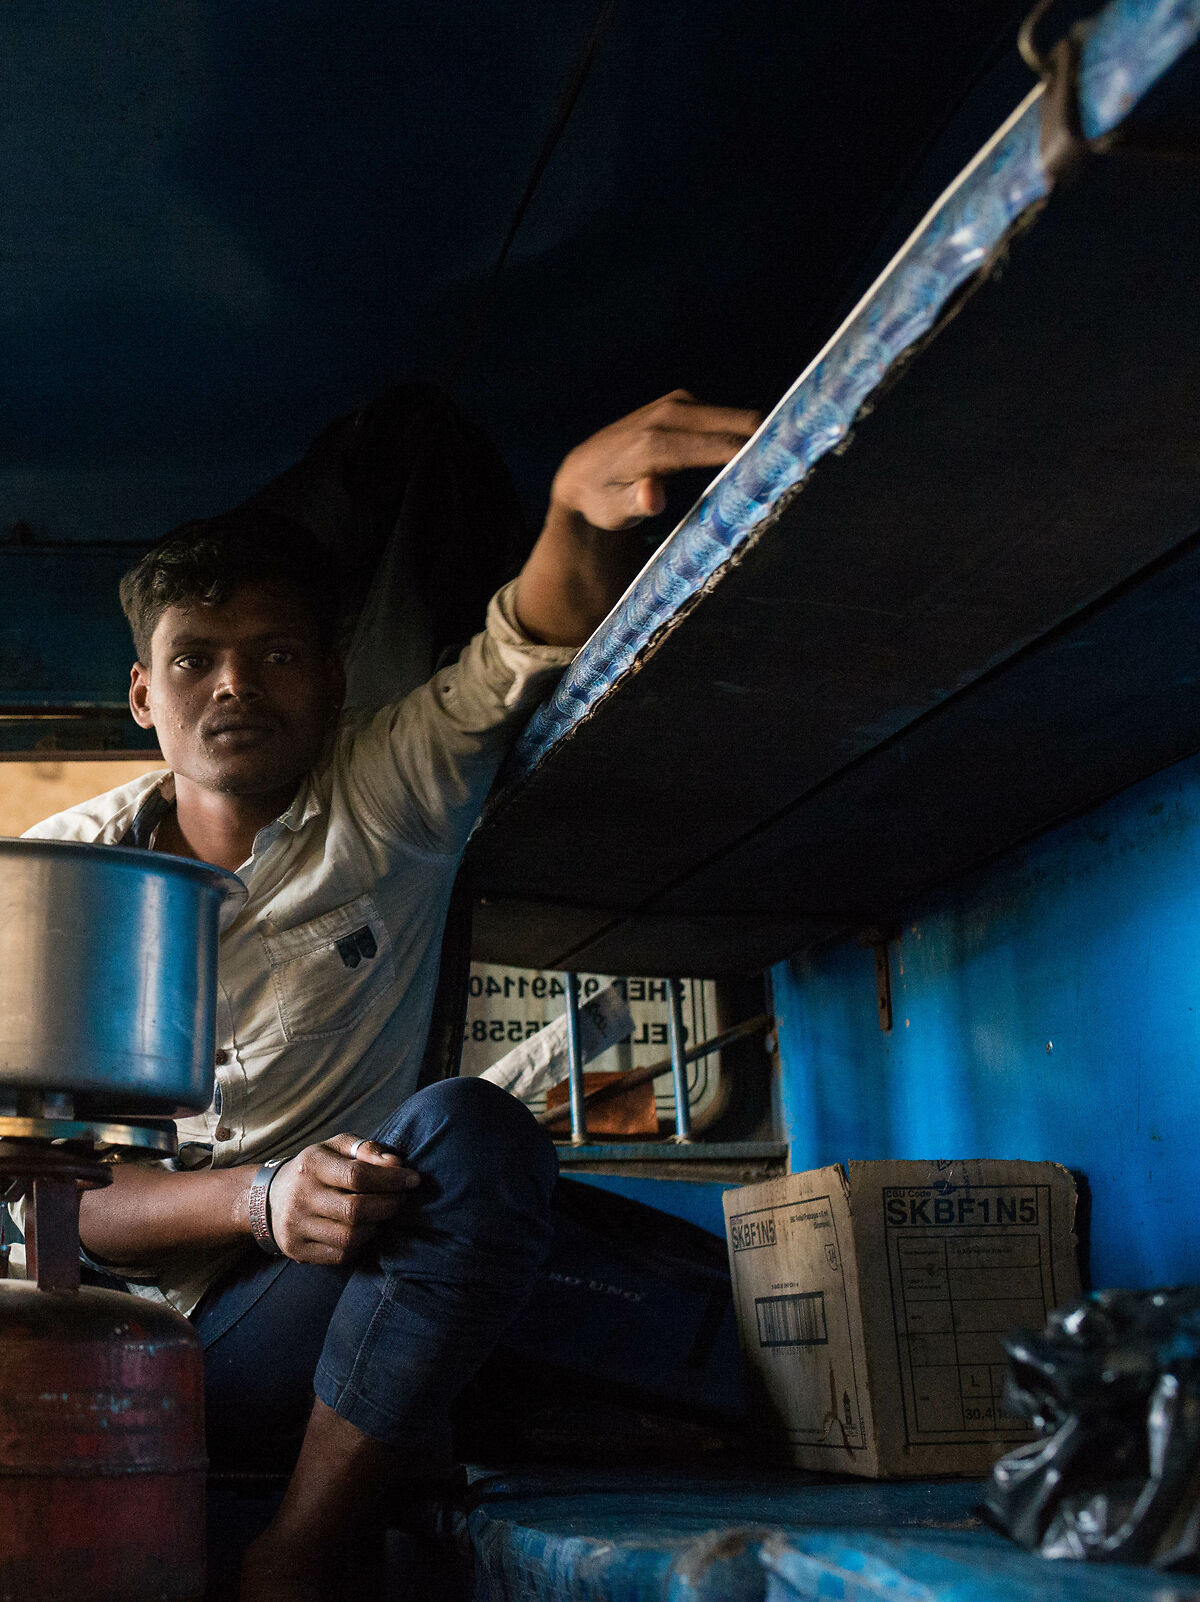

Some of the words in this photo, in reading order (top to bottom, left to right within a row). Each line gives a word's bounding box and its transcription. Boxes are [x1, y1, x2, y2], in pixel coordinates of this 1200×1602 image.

[908, 1189, 932, 1198] Code
[886, 1197, 1036, 1225] SKBF1N5
[732, 1218, 776, 1250] SKBF1N5
